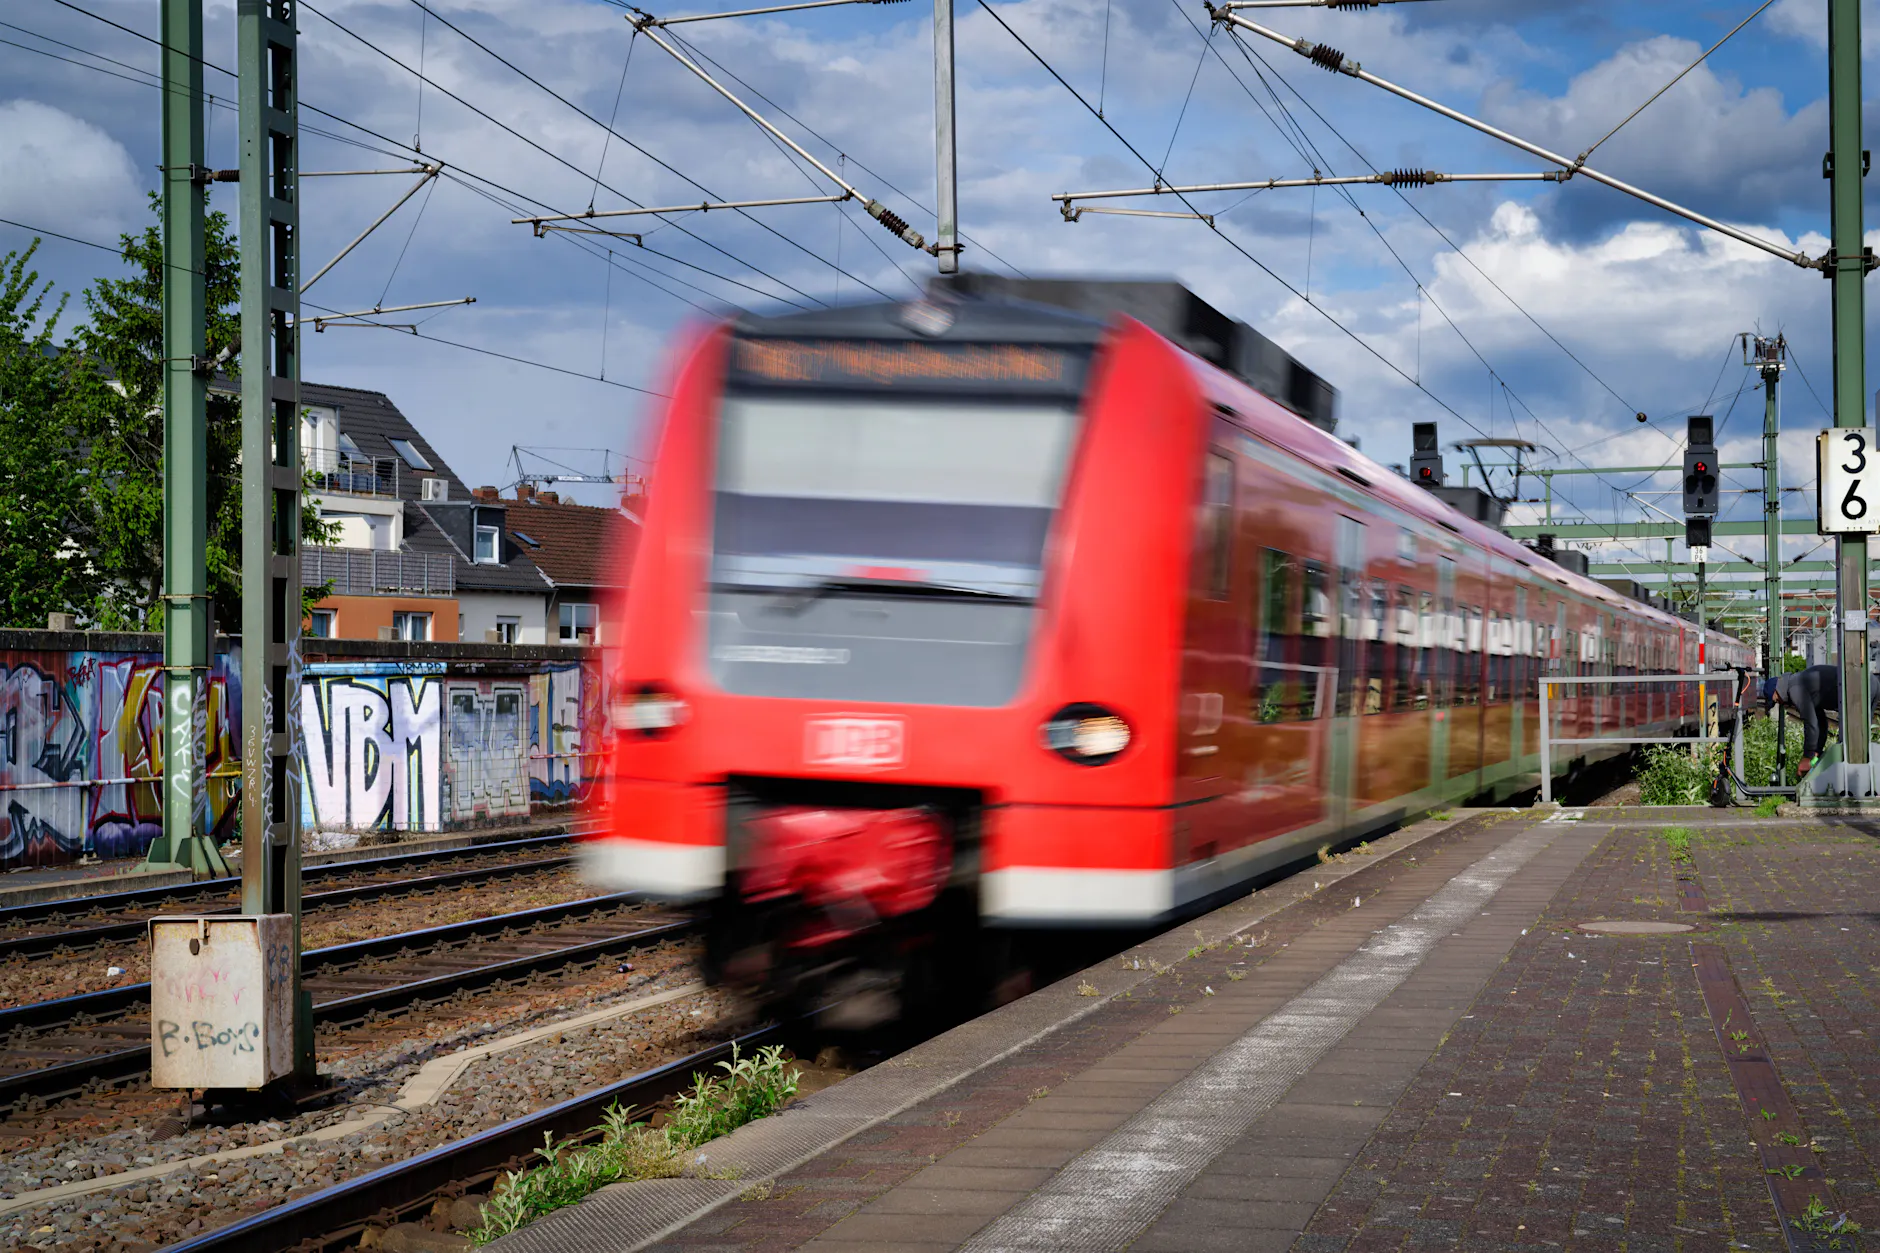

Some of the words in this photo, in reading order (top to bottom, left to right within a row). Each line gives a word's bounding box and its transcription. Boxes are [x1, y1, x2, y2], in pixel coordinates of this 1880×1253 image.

[1841, 433, 1867, 474] 3
[1841, 479, 1867, 520] 6
[301, 675, 444, 833] VBM
